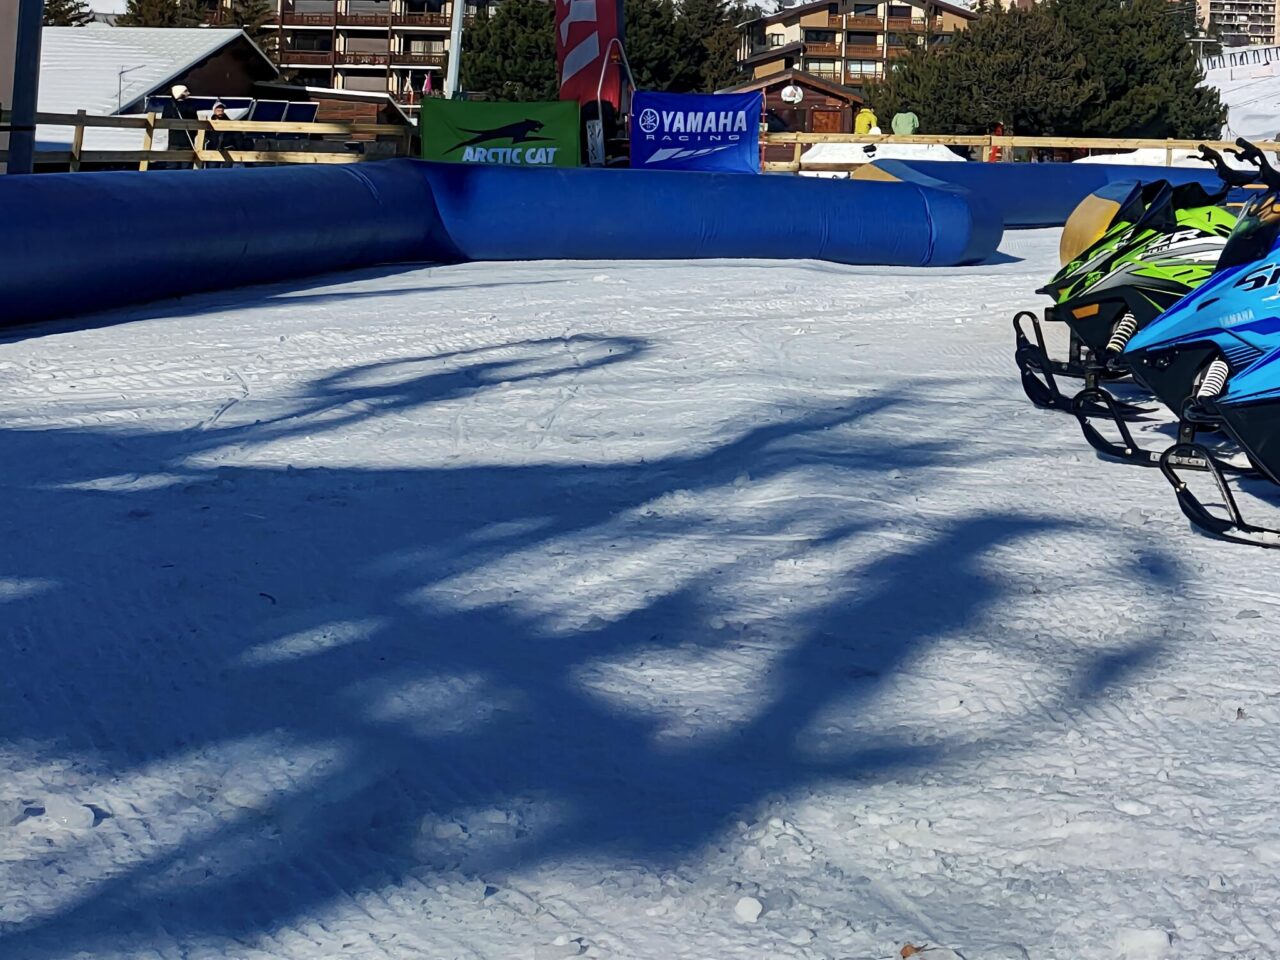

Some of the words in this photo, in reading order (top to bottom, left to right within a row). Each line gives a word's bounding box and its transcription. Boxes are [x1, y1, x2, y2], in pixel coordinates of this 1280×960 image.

[661, 110, 747, 133] YAMAHA
[461, 146, 522, 164] ARCTIC
[525, 147, 558, 164] CAT
[1219, 309, 1255, 327] YAMAHA
